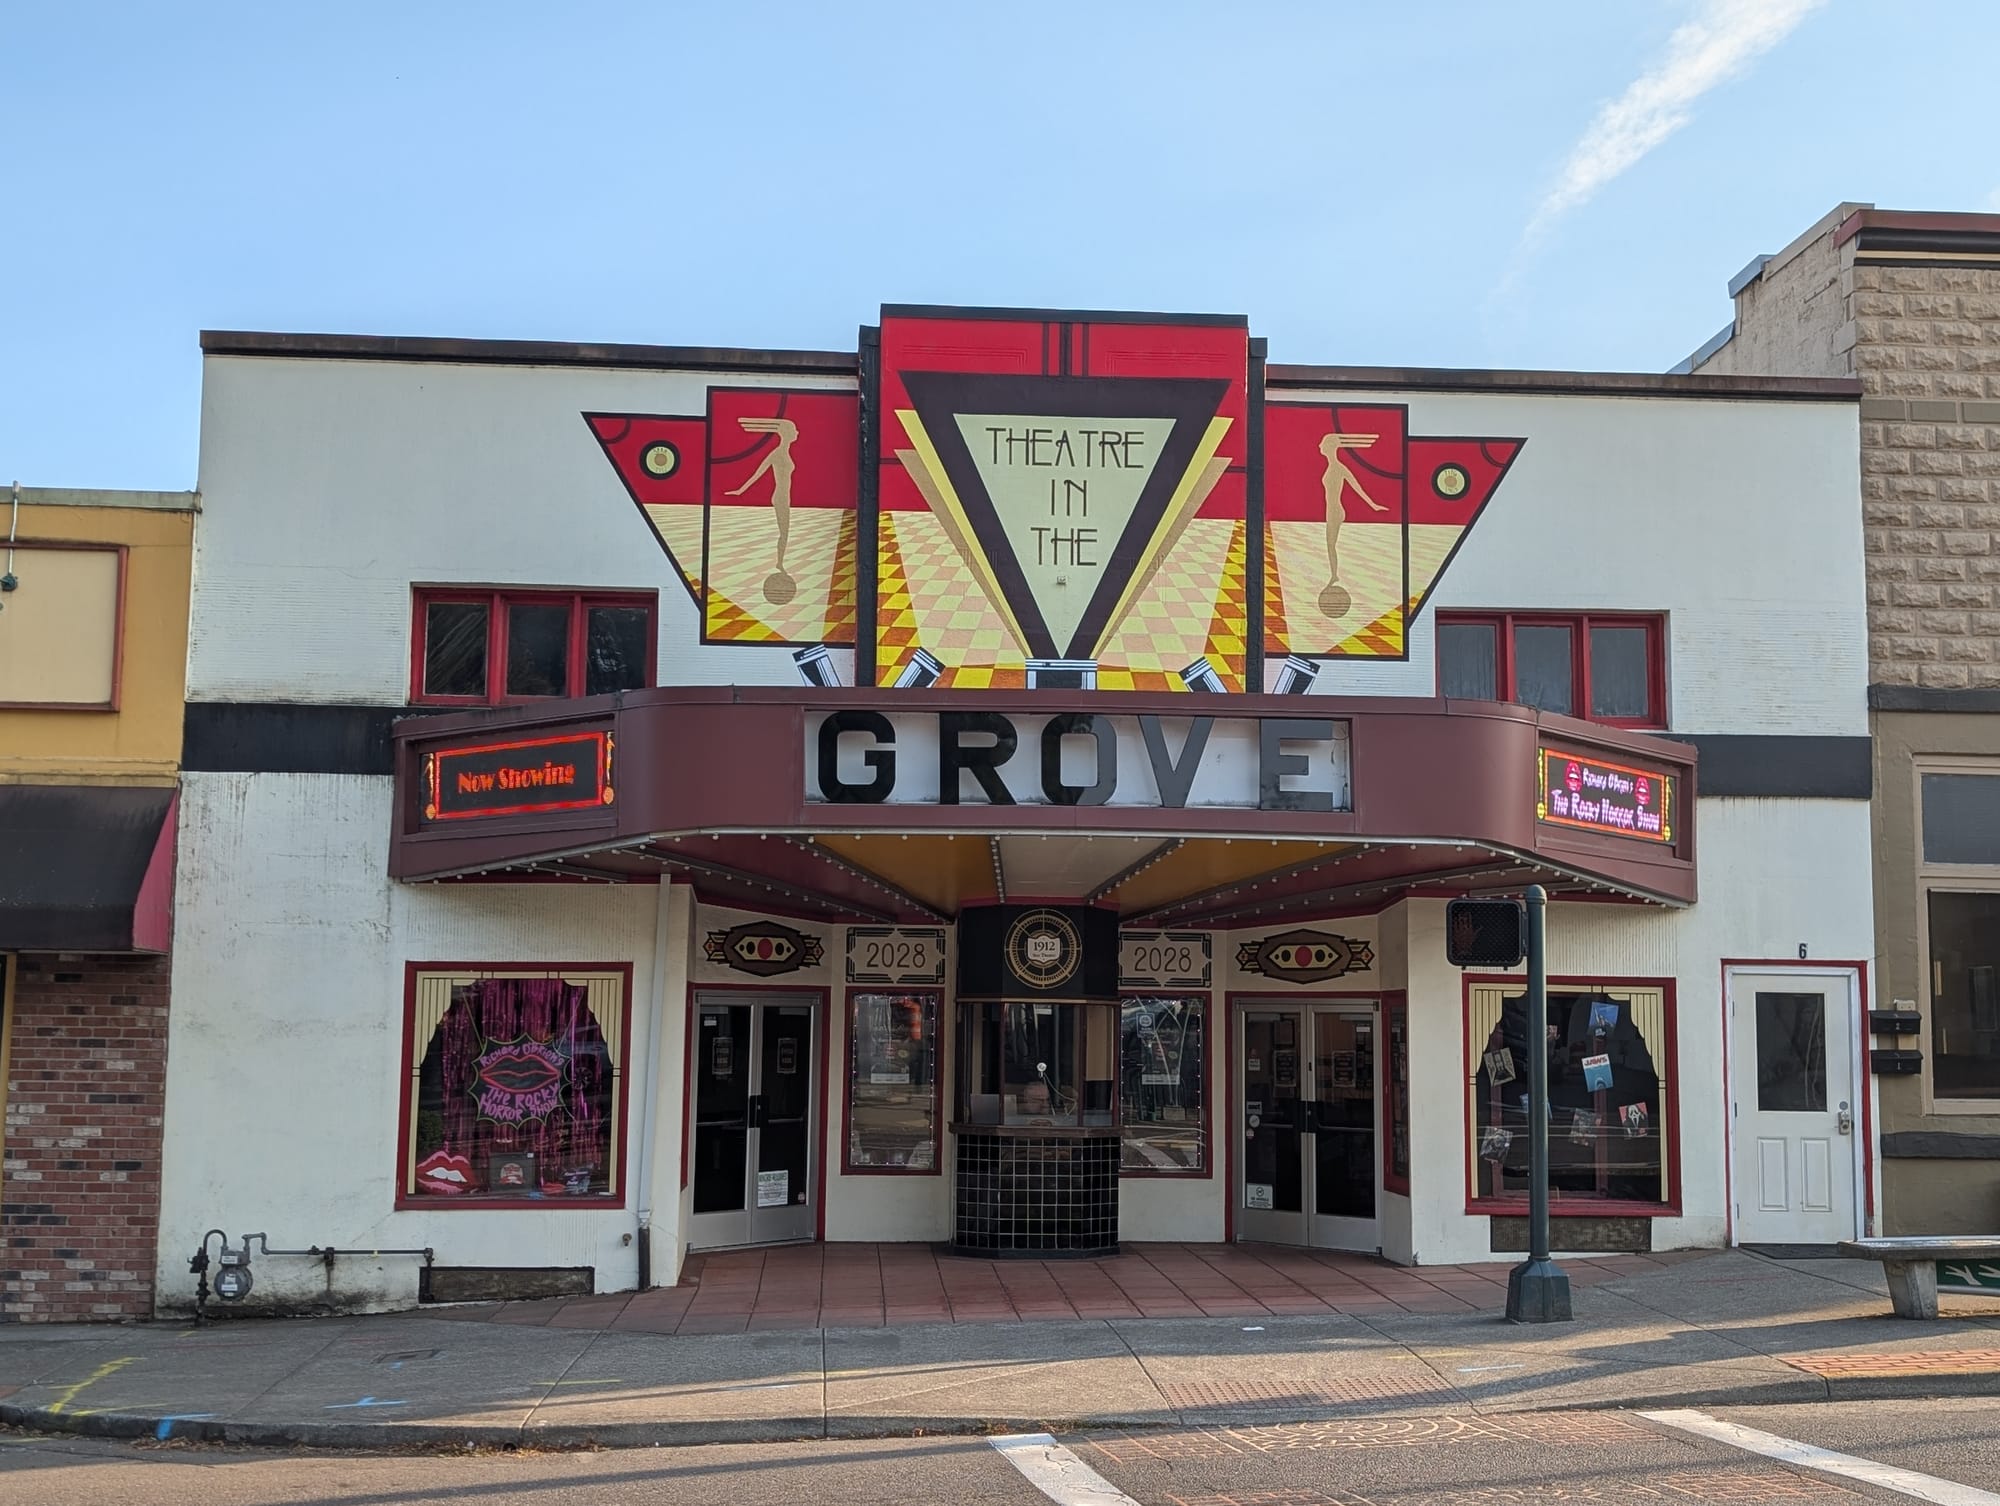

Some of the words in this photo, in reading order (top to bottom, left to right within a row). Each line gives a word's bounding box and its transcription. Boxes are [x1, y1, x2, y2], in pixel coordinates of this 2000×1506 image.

[985, 427, 1144, 468] THEATRE
[1051, 478, 1087, 517] IN
[1030, 527, 1098, 566] THE
[817, 710, 1335, 811] GROVE
[458, 772, 494, 794] Now
[498, 761, 575, 789] Showing
[866, 942, 926, 968] 2028
[1033, 941, 1056, 952] 1912
[1134, 947, 1191, 972] 2028
[1799, 943, 1807, 959] 6
[1584, 1056, 1608, 1066] JAWS
[479, 1093, 523, 1121] HORROR
[529, 1097, 558, 1117] SHOW
[515, 1081, 560, 1111] ROCKY
